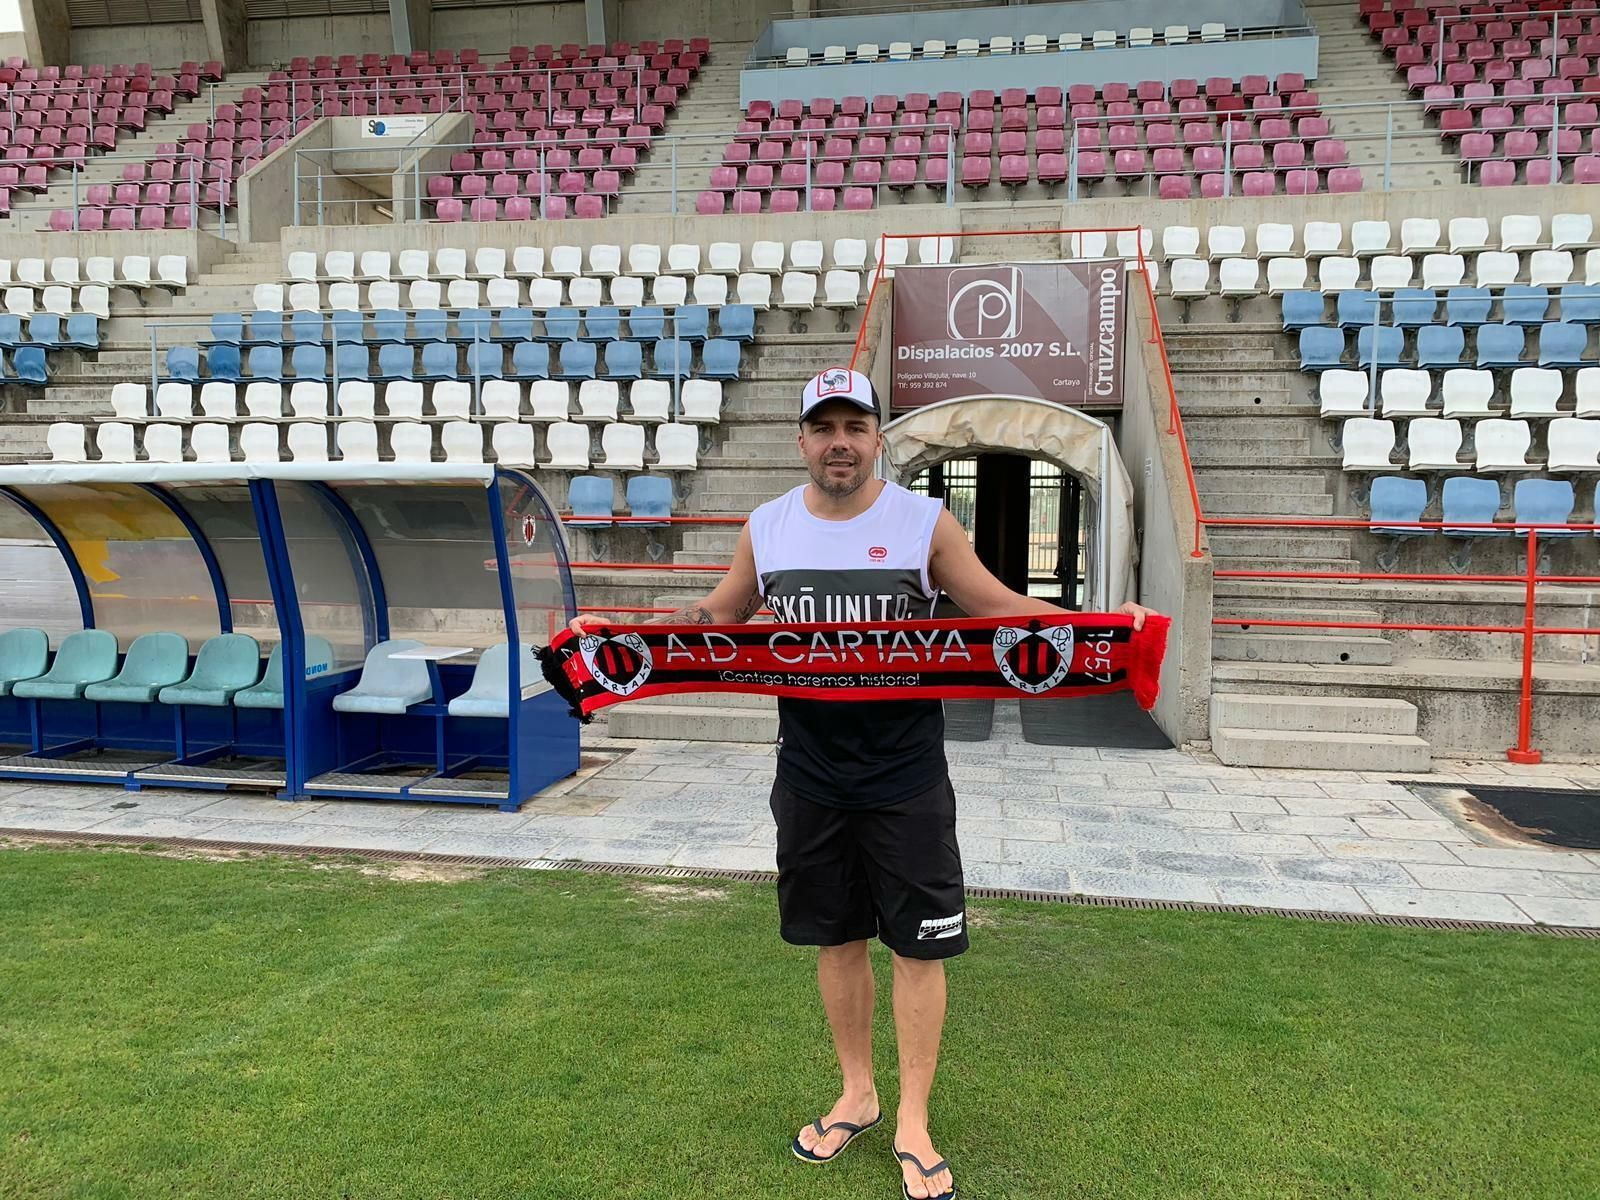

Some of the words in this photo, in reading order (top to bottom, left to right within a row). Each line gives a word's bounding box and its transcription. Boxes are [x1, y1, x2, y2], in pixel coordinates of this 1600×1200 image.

[1094, 267, 1122, 396] Cruzcampo
[897, 344, 995, 362] Dispalacios
[999, 343, 1044, 357] 2007
[1049, 342, 1081, 356] S.L.
[1052, 378, 1081, 387] Cartaya
[666, 632, 753, 663] A.D.
[768, 629, 972, 664] CARTAYA
[594, 663, 651, 695] CARTAYA
[787, 672, 856, 687] haremos
[860, 672, 921, 687] historia!
[1001, 664, 1067, 693] CARTAYA
